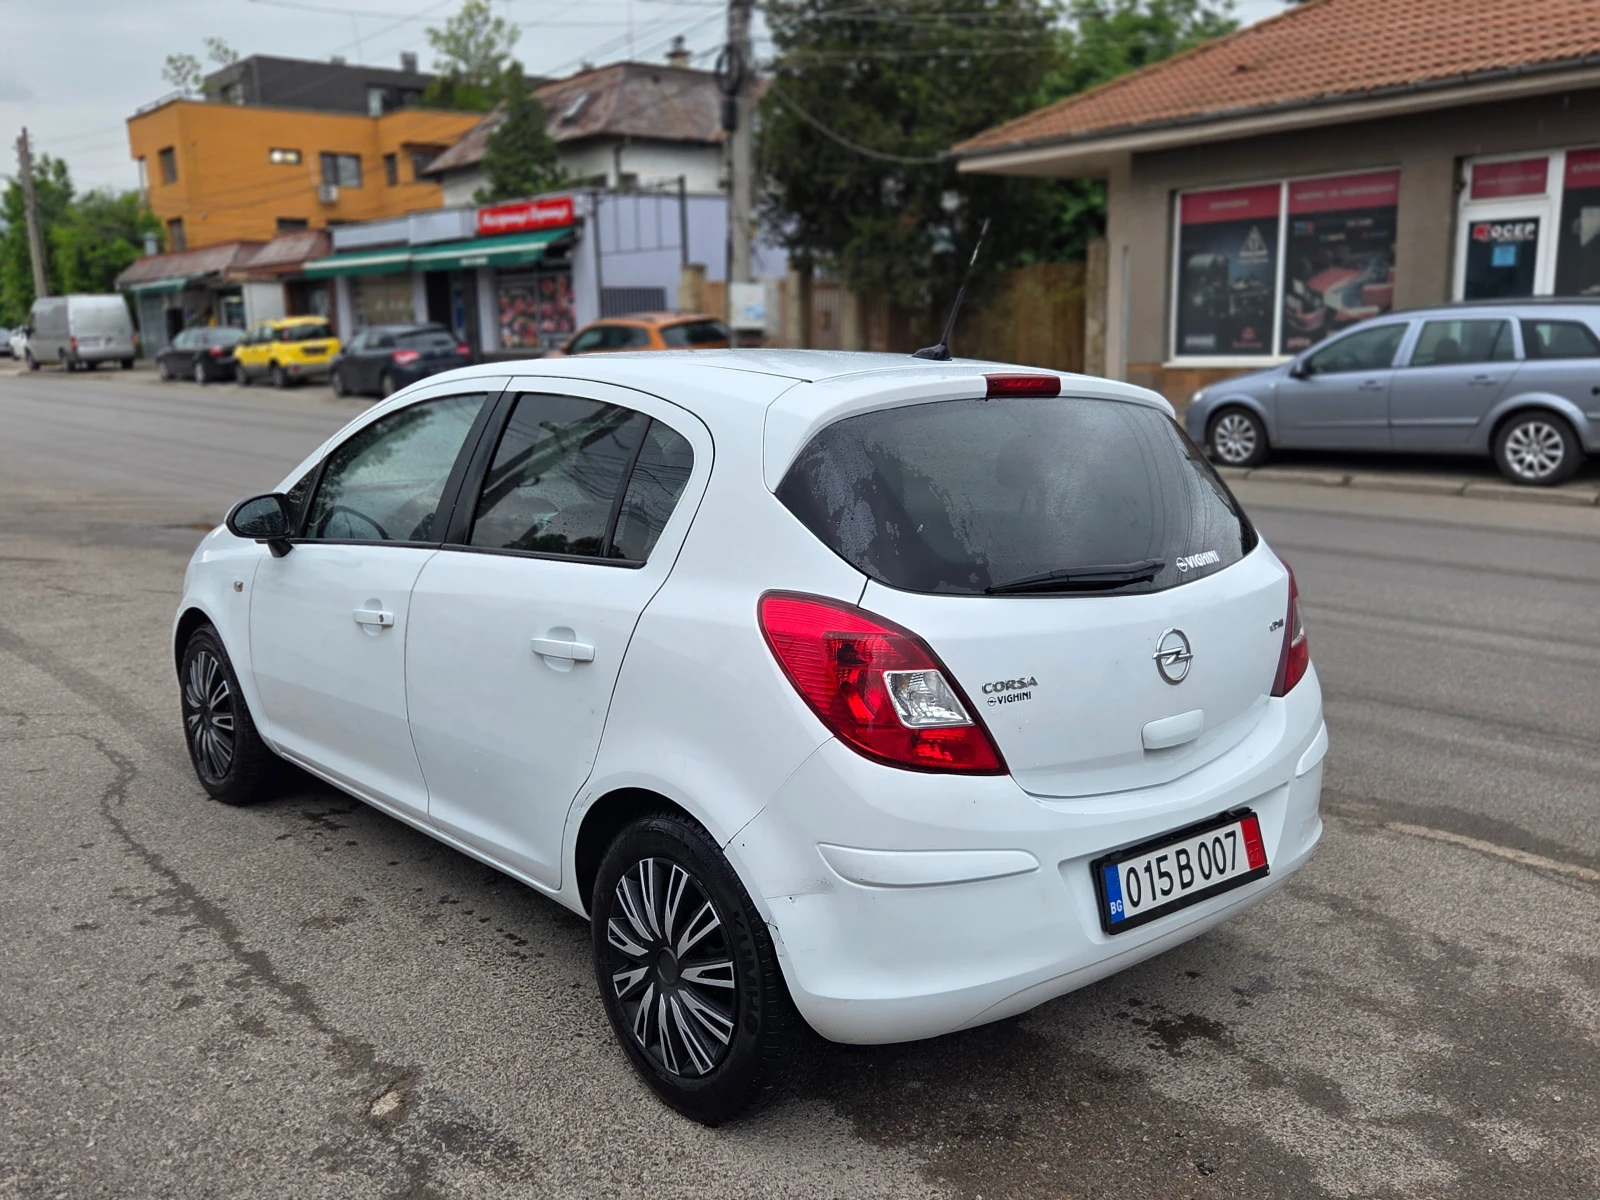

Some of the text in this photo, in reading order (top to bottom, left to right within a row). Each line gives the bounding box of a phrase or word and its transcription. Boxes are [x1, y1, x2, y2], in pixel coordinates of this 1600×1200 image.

[1184, 550, 1219, 568] VIGHINI
[981, 676, 1038, 694] CORSA
[997, 691, 1031, 704] VIGHINI
[1109, 899, 1123, 915] BG
[732, 910, 760, 1036] KUMHO
